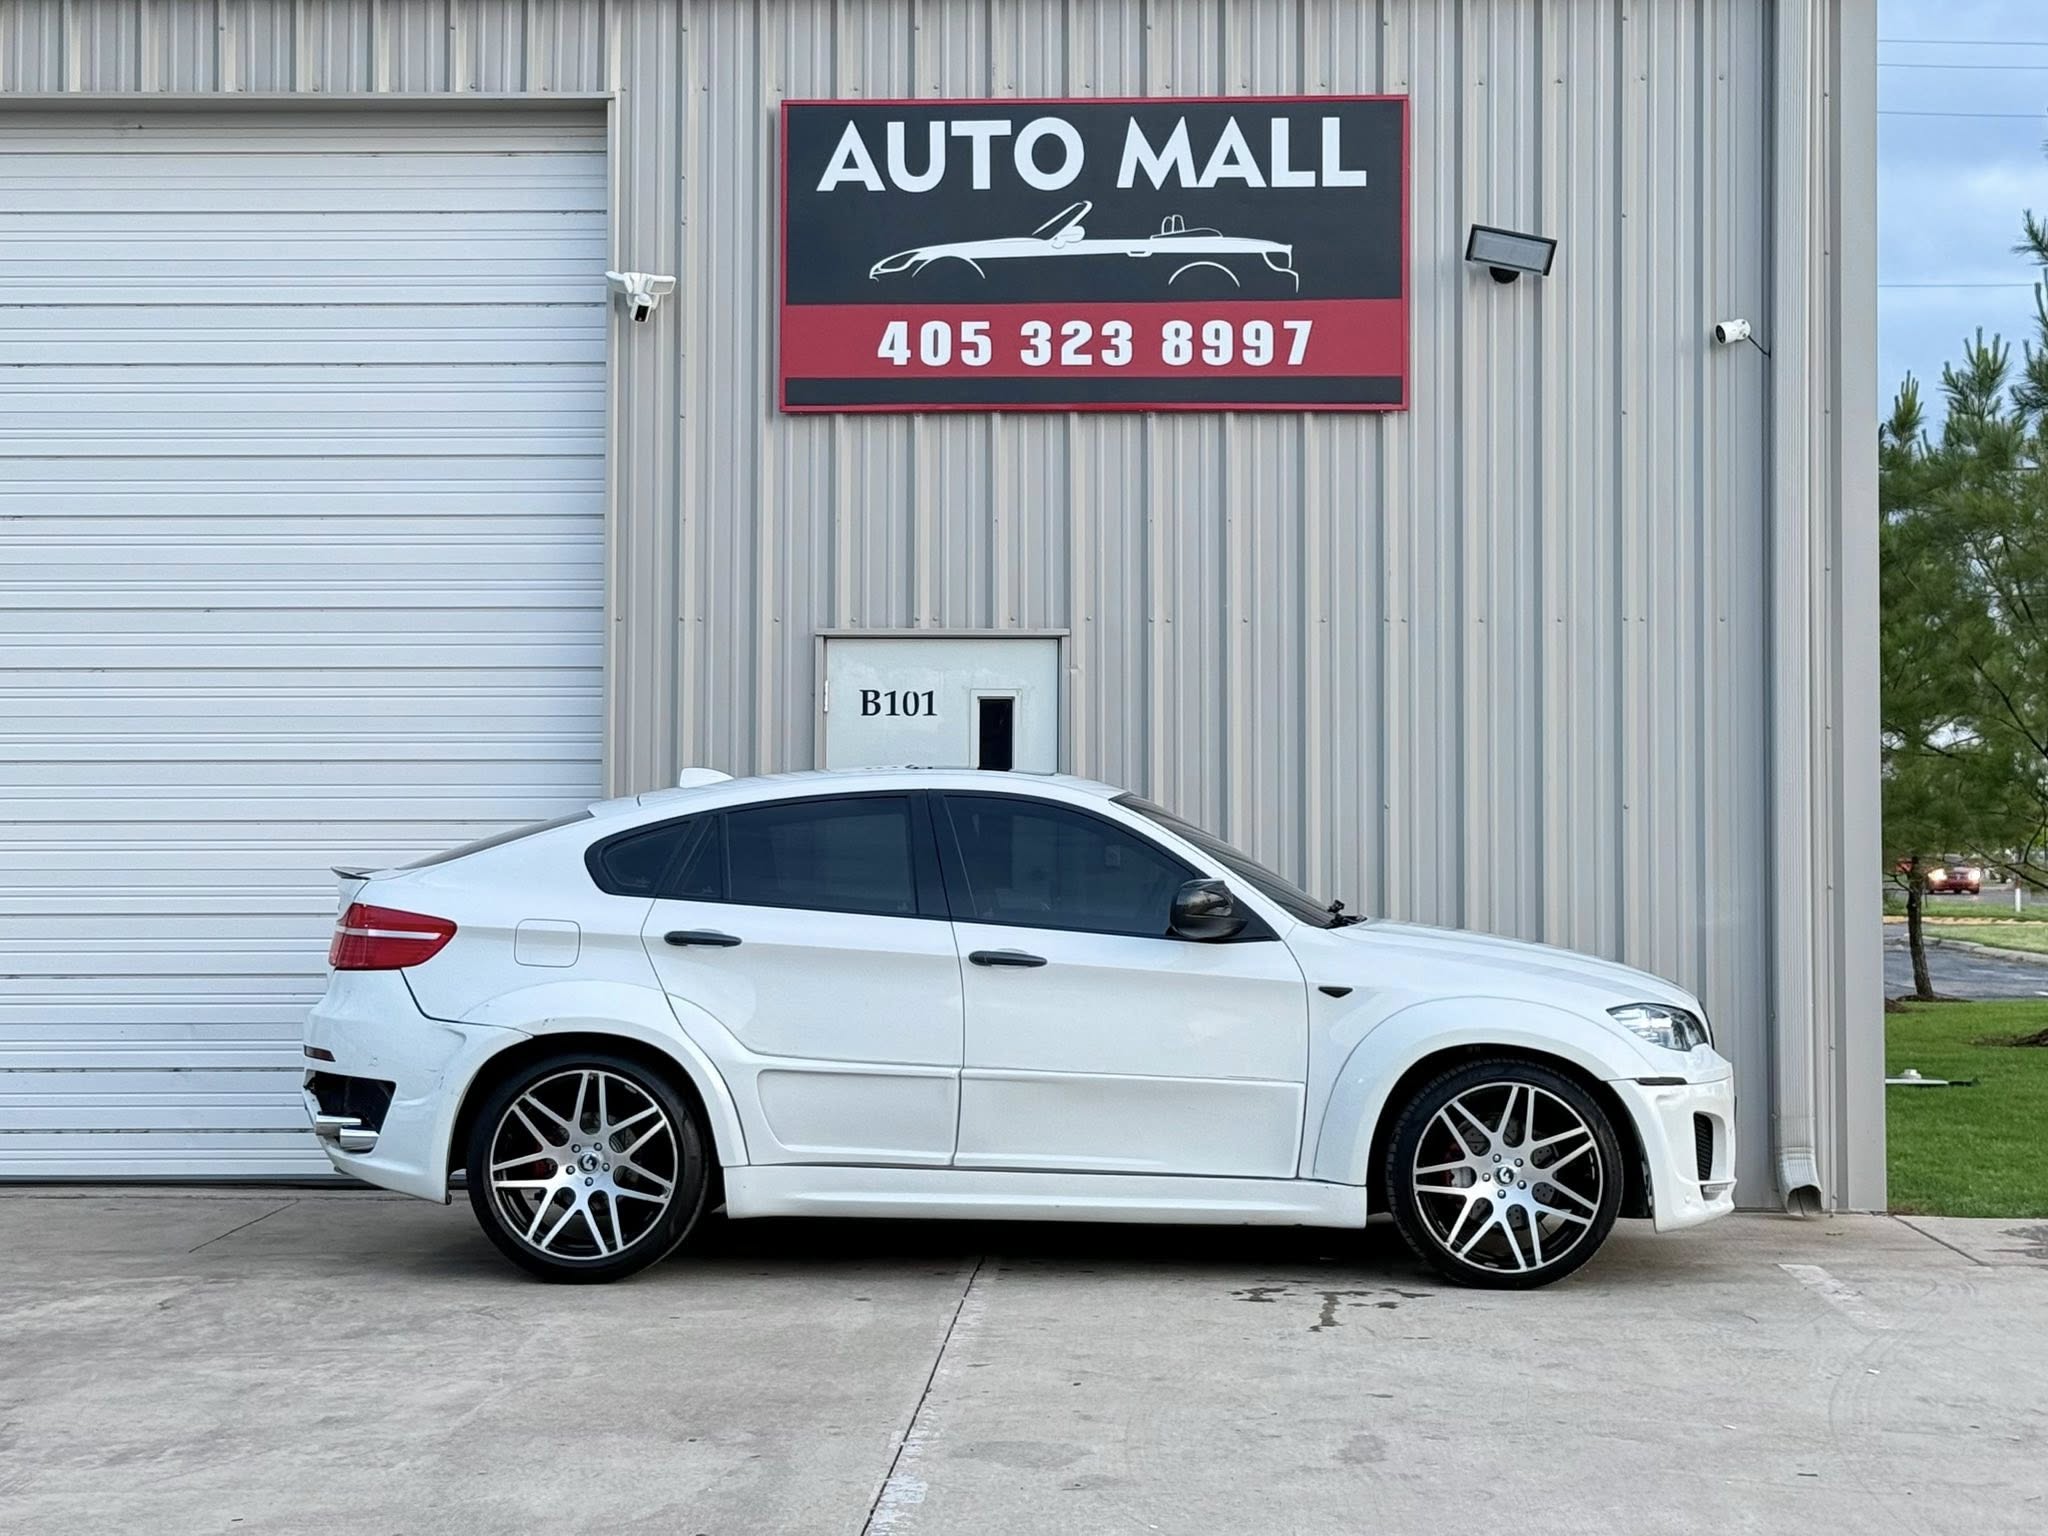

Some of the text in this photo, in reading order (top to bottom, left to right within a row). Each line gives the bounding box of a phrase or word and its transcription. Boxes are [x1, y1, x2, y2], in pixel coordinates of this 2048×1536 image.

[816, 115, 1367, 193] AUTO MALL
[877, 319, 1313, 367] 405 323 8997
[859, 689, 938, 717] B101
